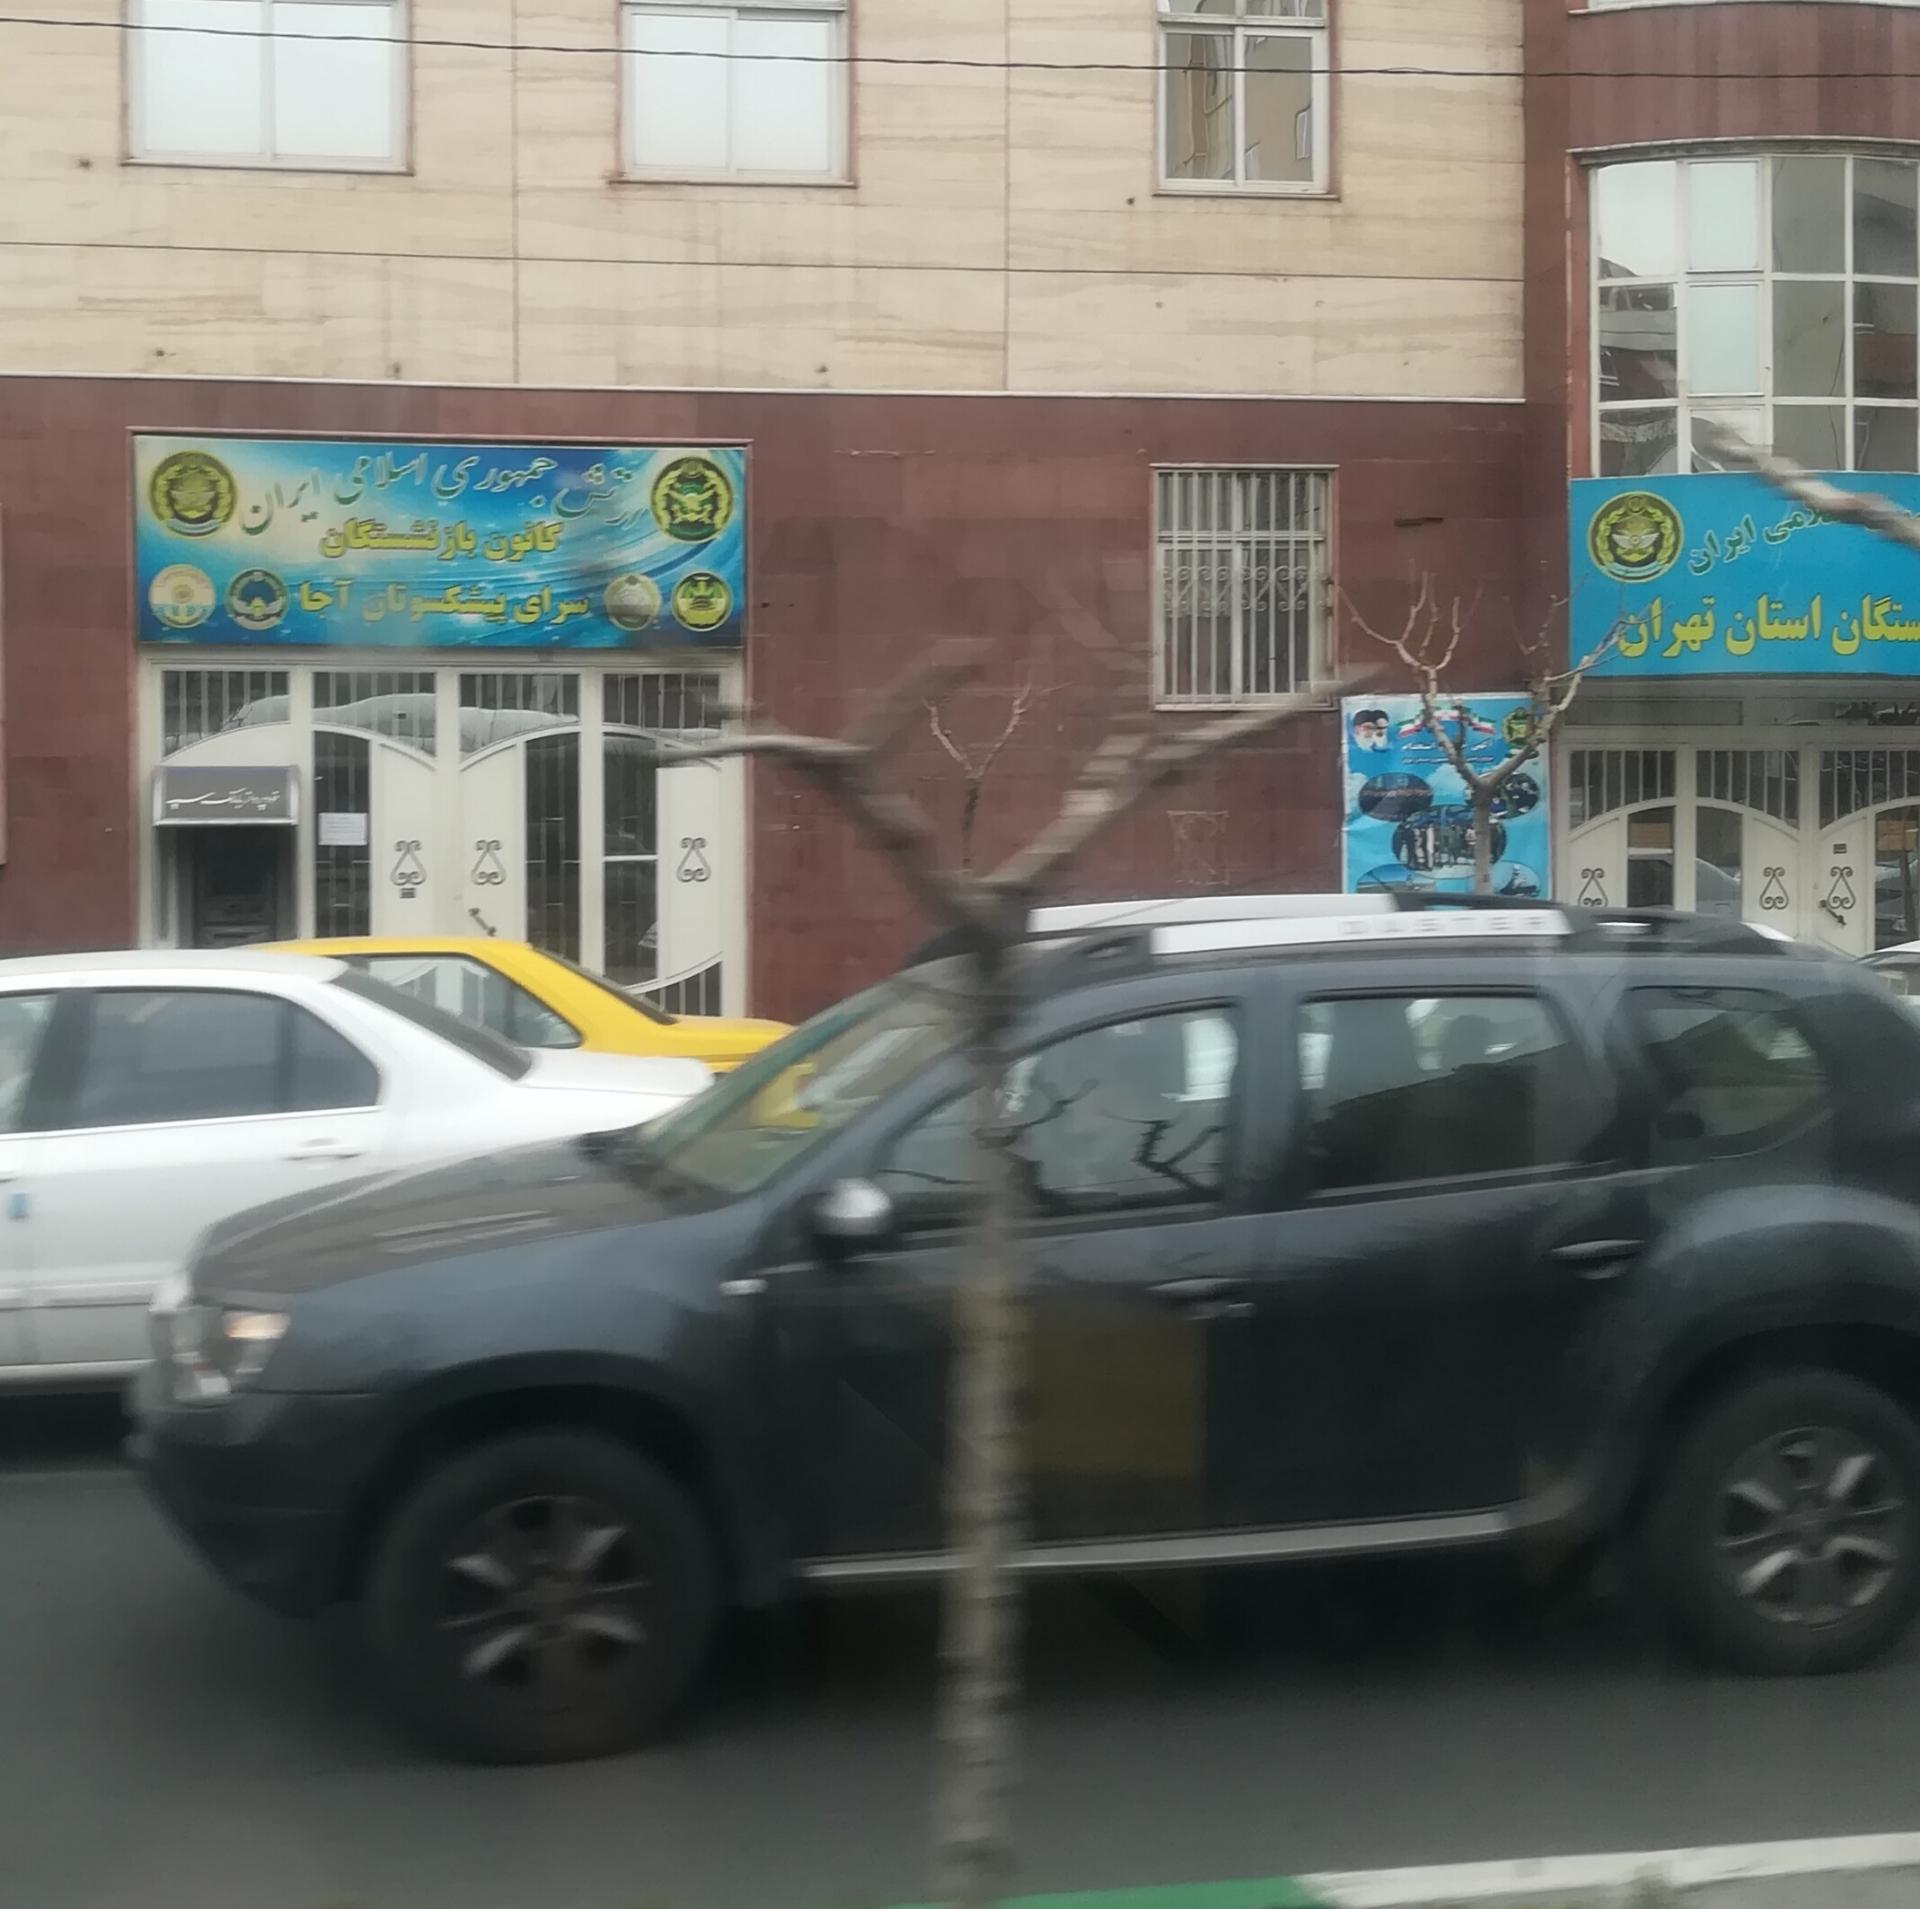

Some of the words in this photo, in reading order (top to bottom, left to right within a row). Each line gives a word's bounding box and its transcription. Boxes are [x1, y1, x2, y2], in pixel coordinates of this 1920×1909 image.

[239, 466, 321, 536] ایران
[333, 451, 428, 506] اسلامی
[319, 517, 478, 560] بازنشستگان
[482, 519, 563, 561] کانون
[1688, 513, 1755, 576] ایران
[299, 578, 352, 618] آجا
[361, 582, 507, 623] پیشکسوتان
[513, 584, 591, 624] سرای
[1616, 594, 1717, 659] تهران
[1724, 593, 1823, 656] استان
